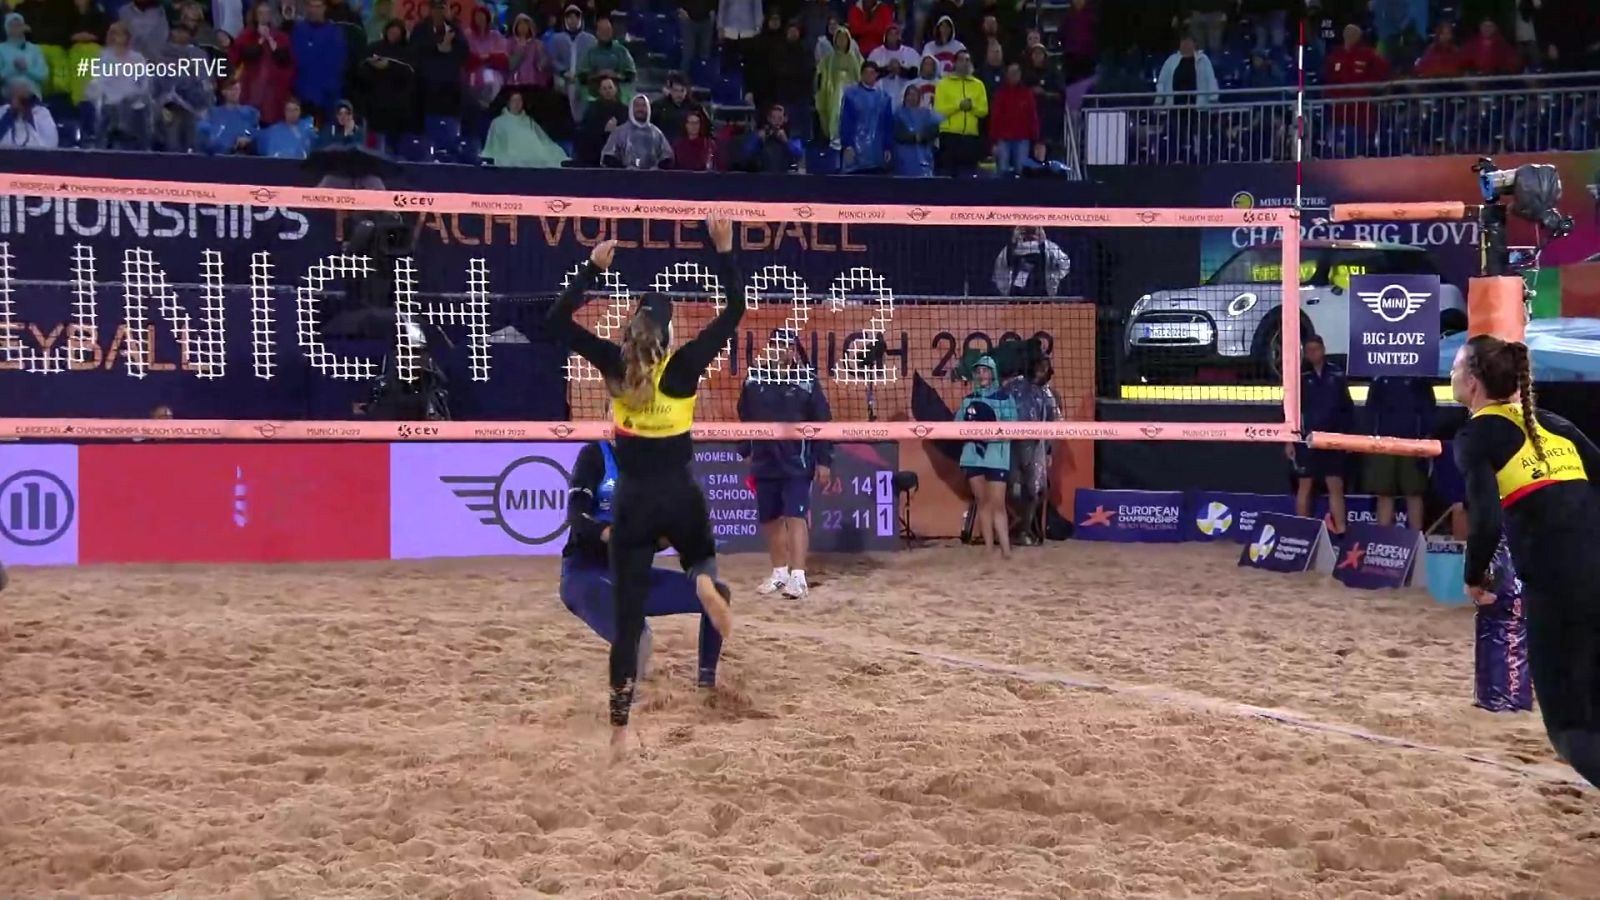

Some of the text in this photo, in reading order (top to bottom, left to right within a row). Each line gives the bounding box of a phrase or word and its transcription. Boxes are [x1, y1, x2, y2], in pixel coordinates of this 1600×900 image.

[410, 197, 434, 206] CEV
[471, 201, 522, 210] MUNICH 2022
[1259, 196, 1326, 206] MINI ELCTRIC
[838, 210, 867, 219] MUNICH
[1257, 212, 1278, 221] CEV
[0, 194, 309, 240] PIONSHIPS
[538, 216, 867, 251] VOLLEBALL
[1354, 223, 1400, 245] BIG
[1381, 297, 1406, 309] MINI
[1362, 332, 1425, 346] BIG LOVE
[1367, 352, 1419, 365] UNITED
[307, 427, 339, 436] MUNICH
[414, 427, 439, 435] CEV
[474, 428, 505, 437] MUNICH
[959, 428, 994, 437] EUROPEAN
[1258, 428, 1280, 437] CEV
[694, 452, 734, 462] WOMEN
[708, 474, 738, 485] STAM
[822, 474, 888, 497] 24 14 1
[505, 489, 565, 511] MINI
[708, 489, 755, 500] SCHOON
[1119, 504, 1180, 516] EUROPEAN
[821, 507, 888, 530] 22 11 1
[1367, 542, 1411, 560] EUROPEAN
